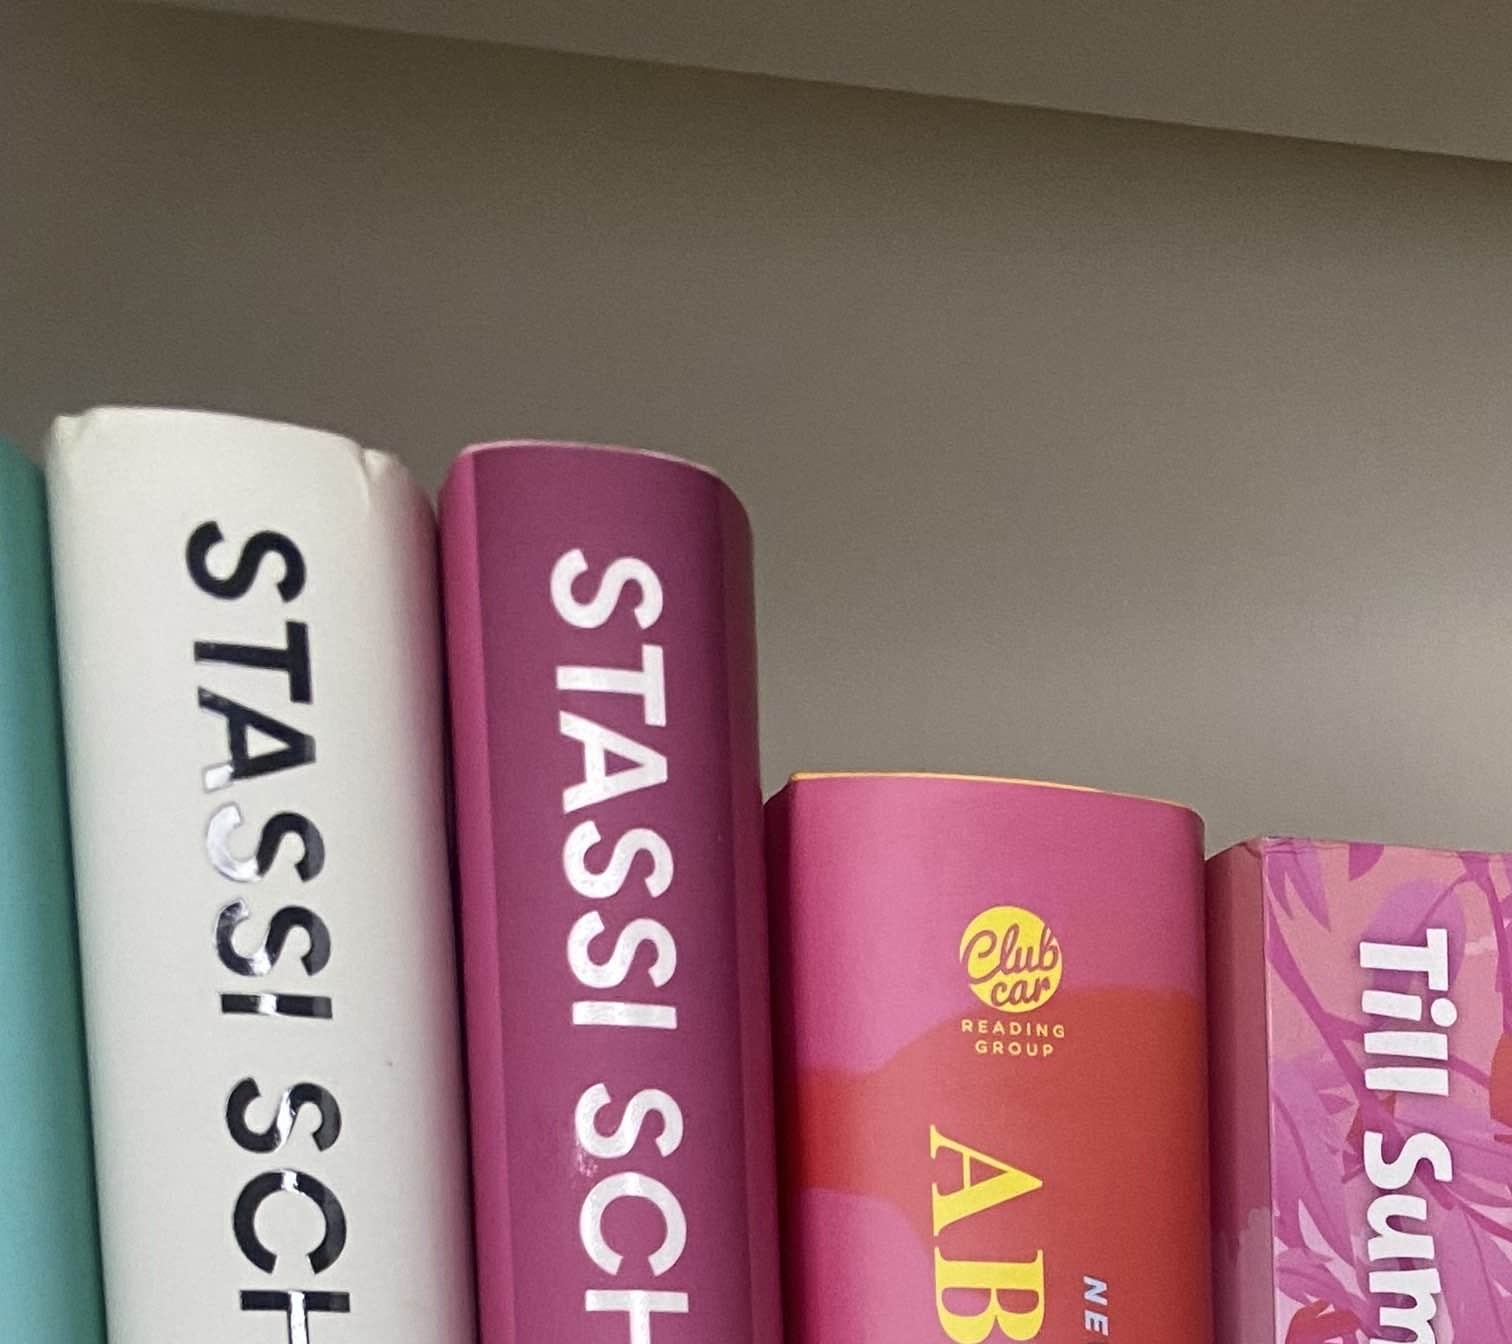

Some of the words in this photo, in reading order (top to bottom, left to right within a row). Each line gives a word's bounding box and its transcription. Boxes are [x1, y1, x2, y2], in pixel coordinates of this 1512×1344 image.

[185, 520, 334, 1023] STASSI
[550, 548, 681, 1029] STASSI
[962, 922, 1059, 985] Club
[990, 977, 1051, 1007] car
[1358, 928, 1459, 1097] Till
[961, 1018, 1065, 1039] READING
[975, 1040, 1054, 1057] GROUP
